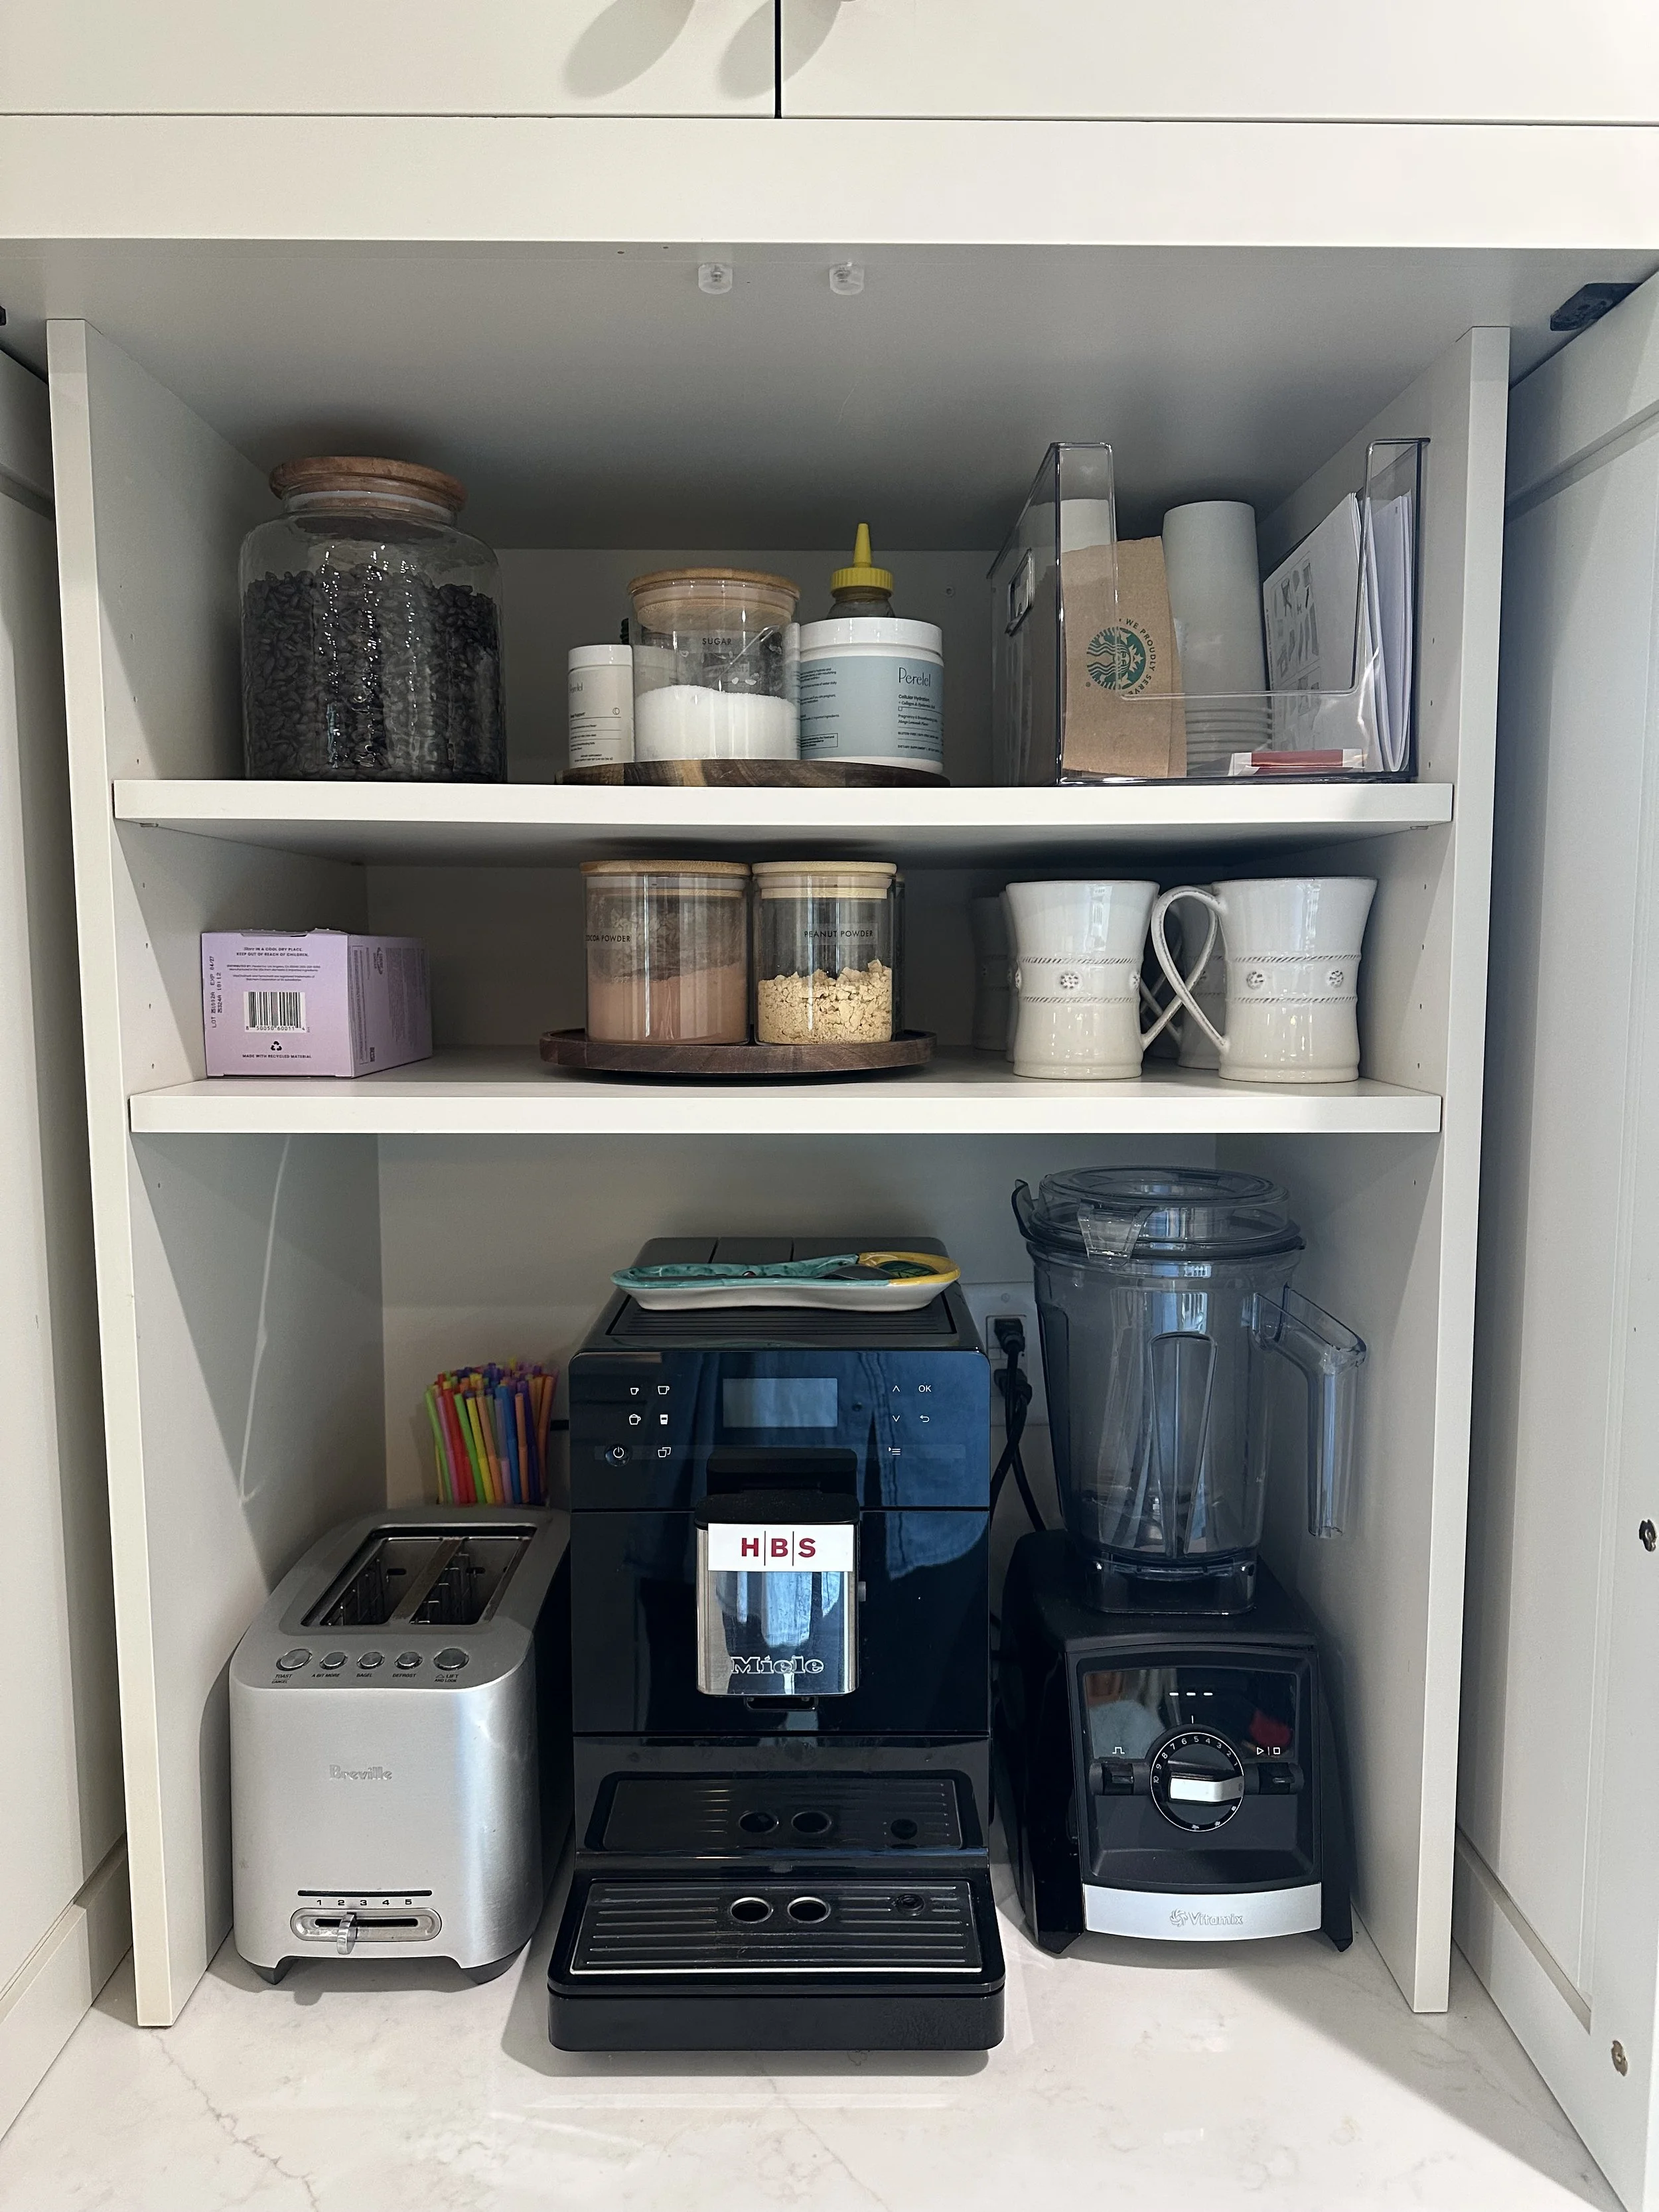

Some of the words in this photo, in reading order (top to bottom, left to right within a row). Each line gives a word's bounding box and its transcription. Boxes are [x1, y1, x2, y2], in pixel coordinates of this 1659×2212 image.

[1125, 618, 1139, 629] WE
[1139, 628, 1156, 672] PROUDLY
[899, 667, 930, 687] Perelel
[730, 1655, 824, 1674] Miele
[329, 1765, 392, 1780] Breville
[1153, 1775, 1159, 1784] 10
[1188, 1911, 1244, 1925] Vitamix
